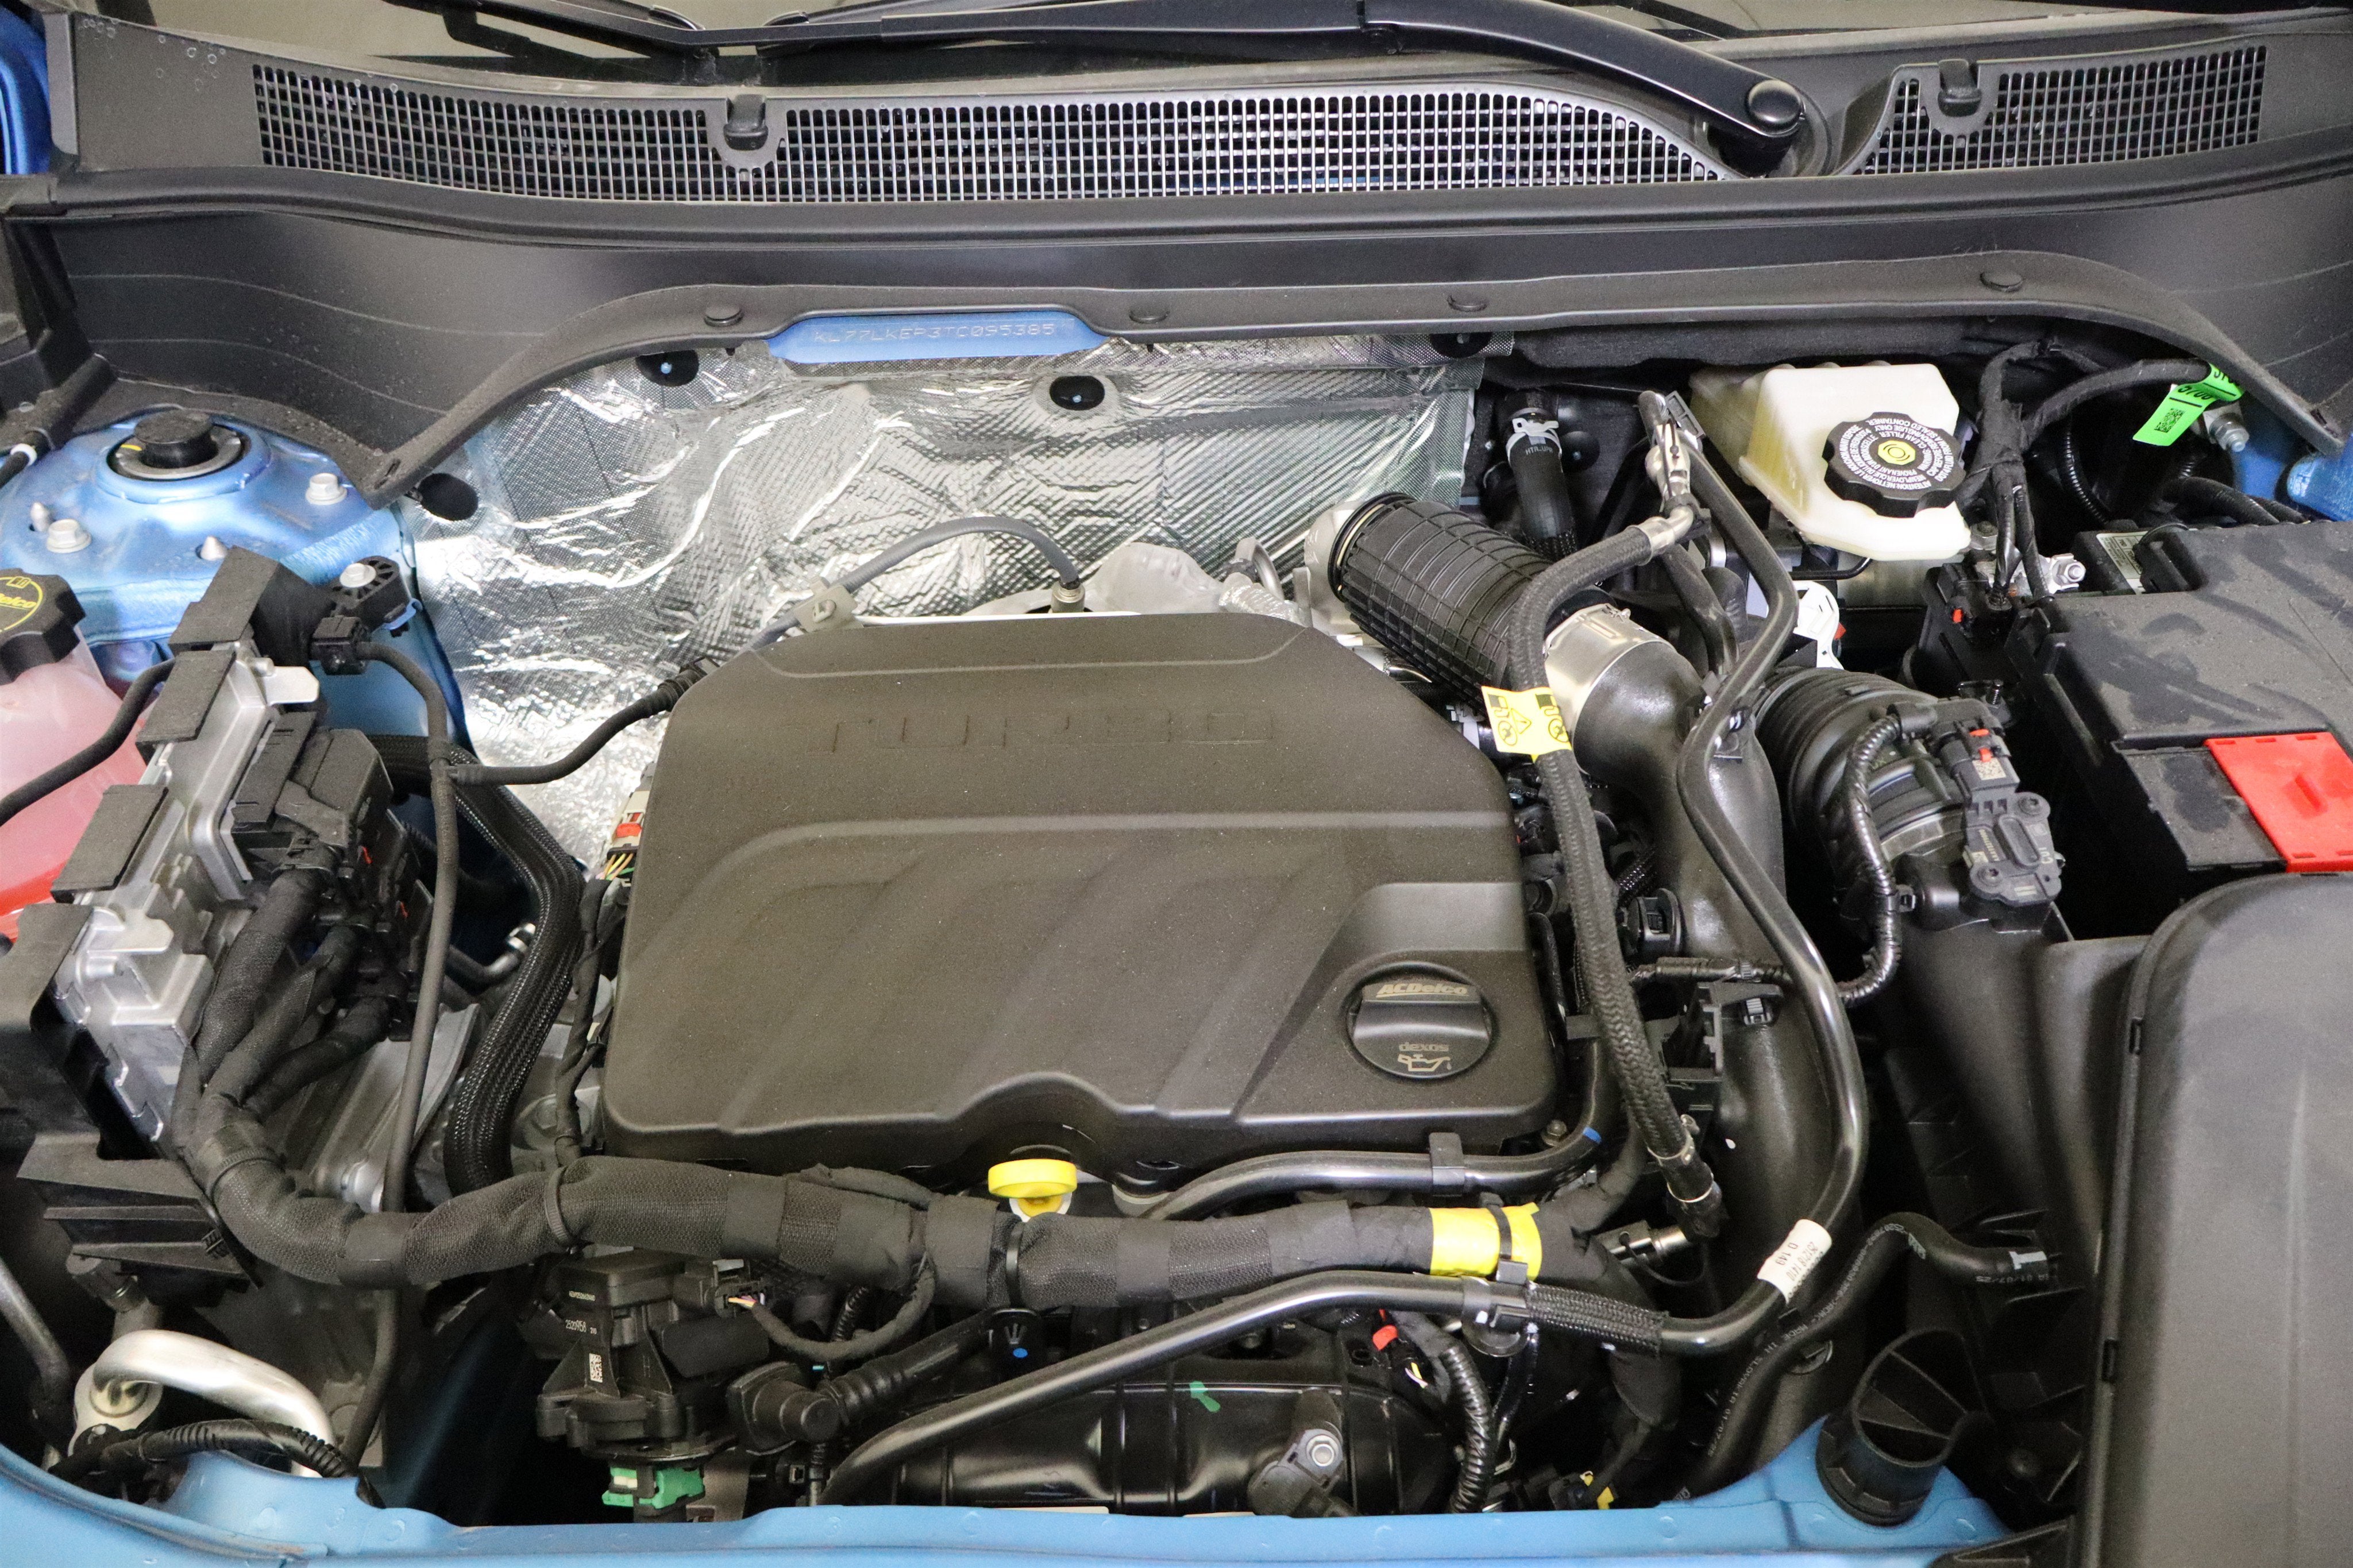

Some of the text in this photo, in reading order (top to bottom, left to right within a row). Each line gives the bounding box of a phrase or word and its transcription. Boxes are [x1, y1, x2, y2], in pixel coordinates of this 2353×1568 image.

[1892, 424, 1908, 433] USE
[1910, 422, 1939, 439] SEALED
[1839, 437, 1849, 451] AVANT
[1904, 434, 1928, 449] CLEAN
[1935, 440, 1954, 455] FROM
[1839, 451, 1861, 471] BOUCHON
[1850, 453, 1870, 469] LIQUIDE
[1930, 449, 1944, 468] BEFORE
[1943, 455, 1954, 470] FLUID
[1853, 469, 1866, 477] LE
[1872, 470, 1888, 480] QUE
[1878, 466, 1918, 477] PROVENANT
[1925, 465, 1941, 477] CAP
[1933, 470, 1950, 482] DOT
[1861, 473, 1896, 490] NETTOYER
[0, 593, 37, 608] elco
[1377, 983, 1468, 995] ACDelco
[1398, 1041, 1449, 1052] dexos
